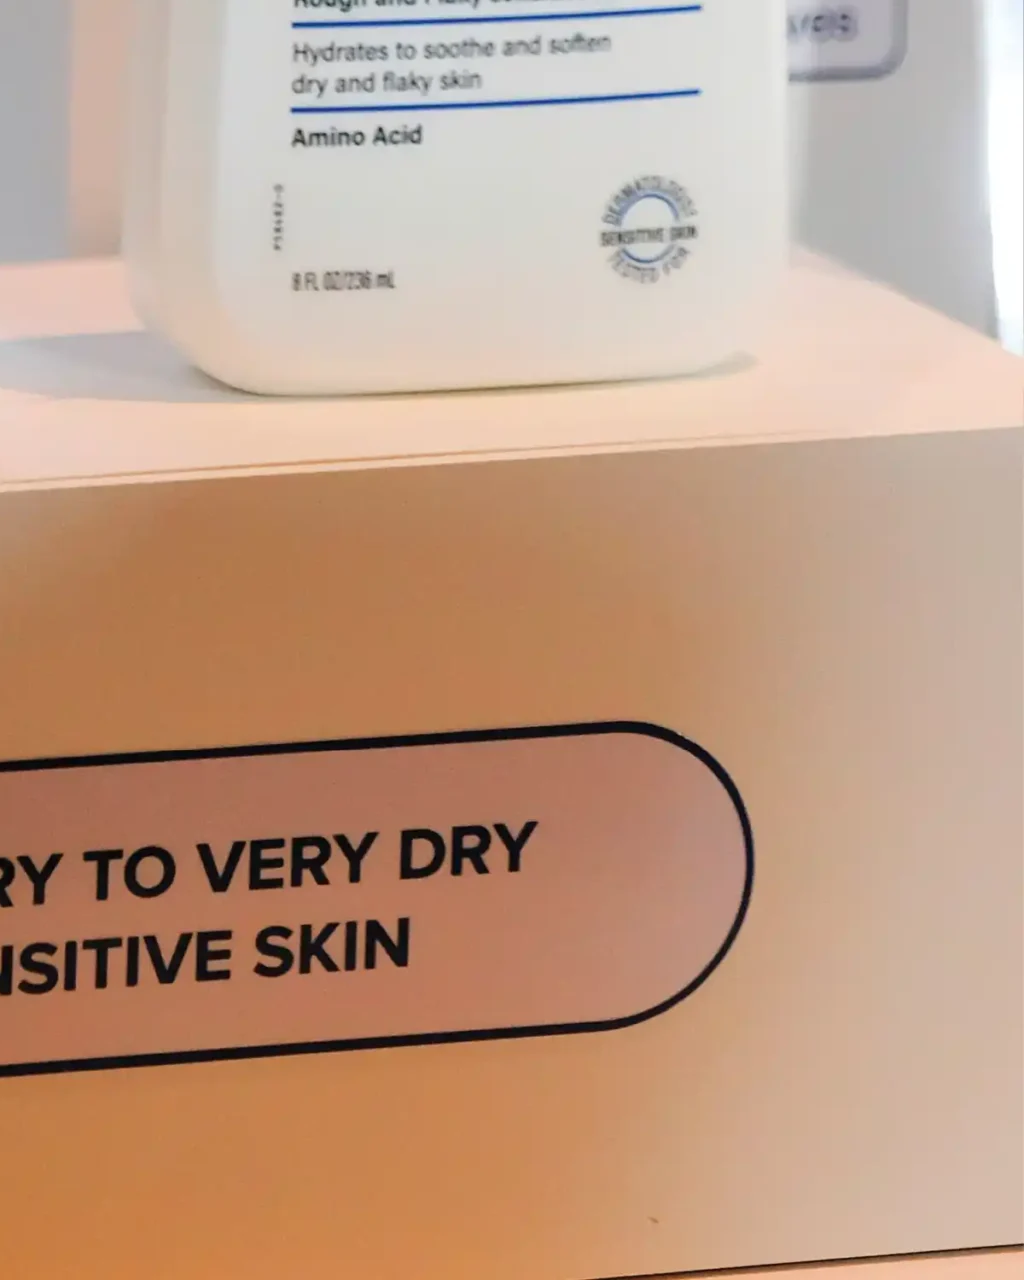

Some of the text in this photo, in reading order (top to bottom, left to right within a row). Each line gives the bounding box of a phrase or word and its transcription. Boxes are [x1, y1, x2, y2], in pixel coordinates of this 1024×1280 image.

[293, 33, 611, 66] Hydrates to soothe and soften
[292, 69, 481, 98] dry and flaky skin
[292, 125, 422, 146] Amino Acid
[83, 845, 176, 901] TO
[196, 832, 379, 892] VERY
[400, 821, 538, 879] DRY
[254, 917, 409, 977] SKIN
